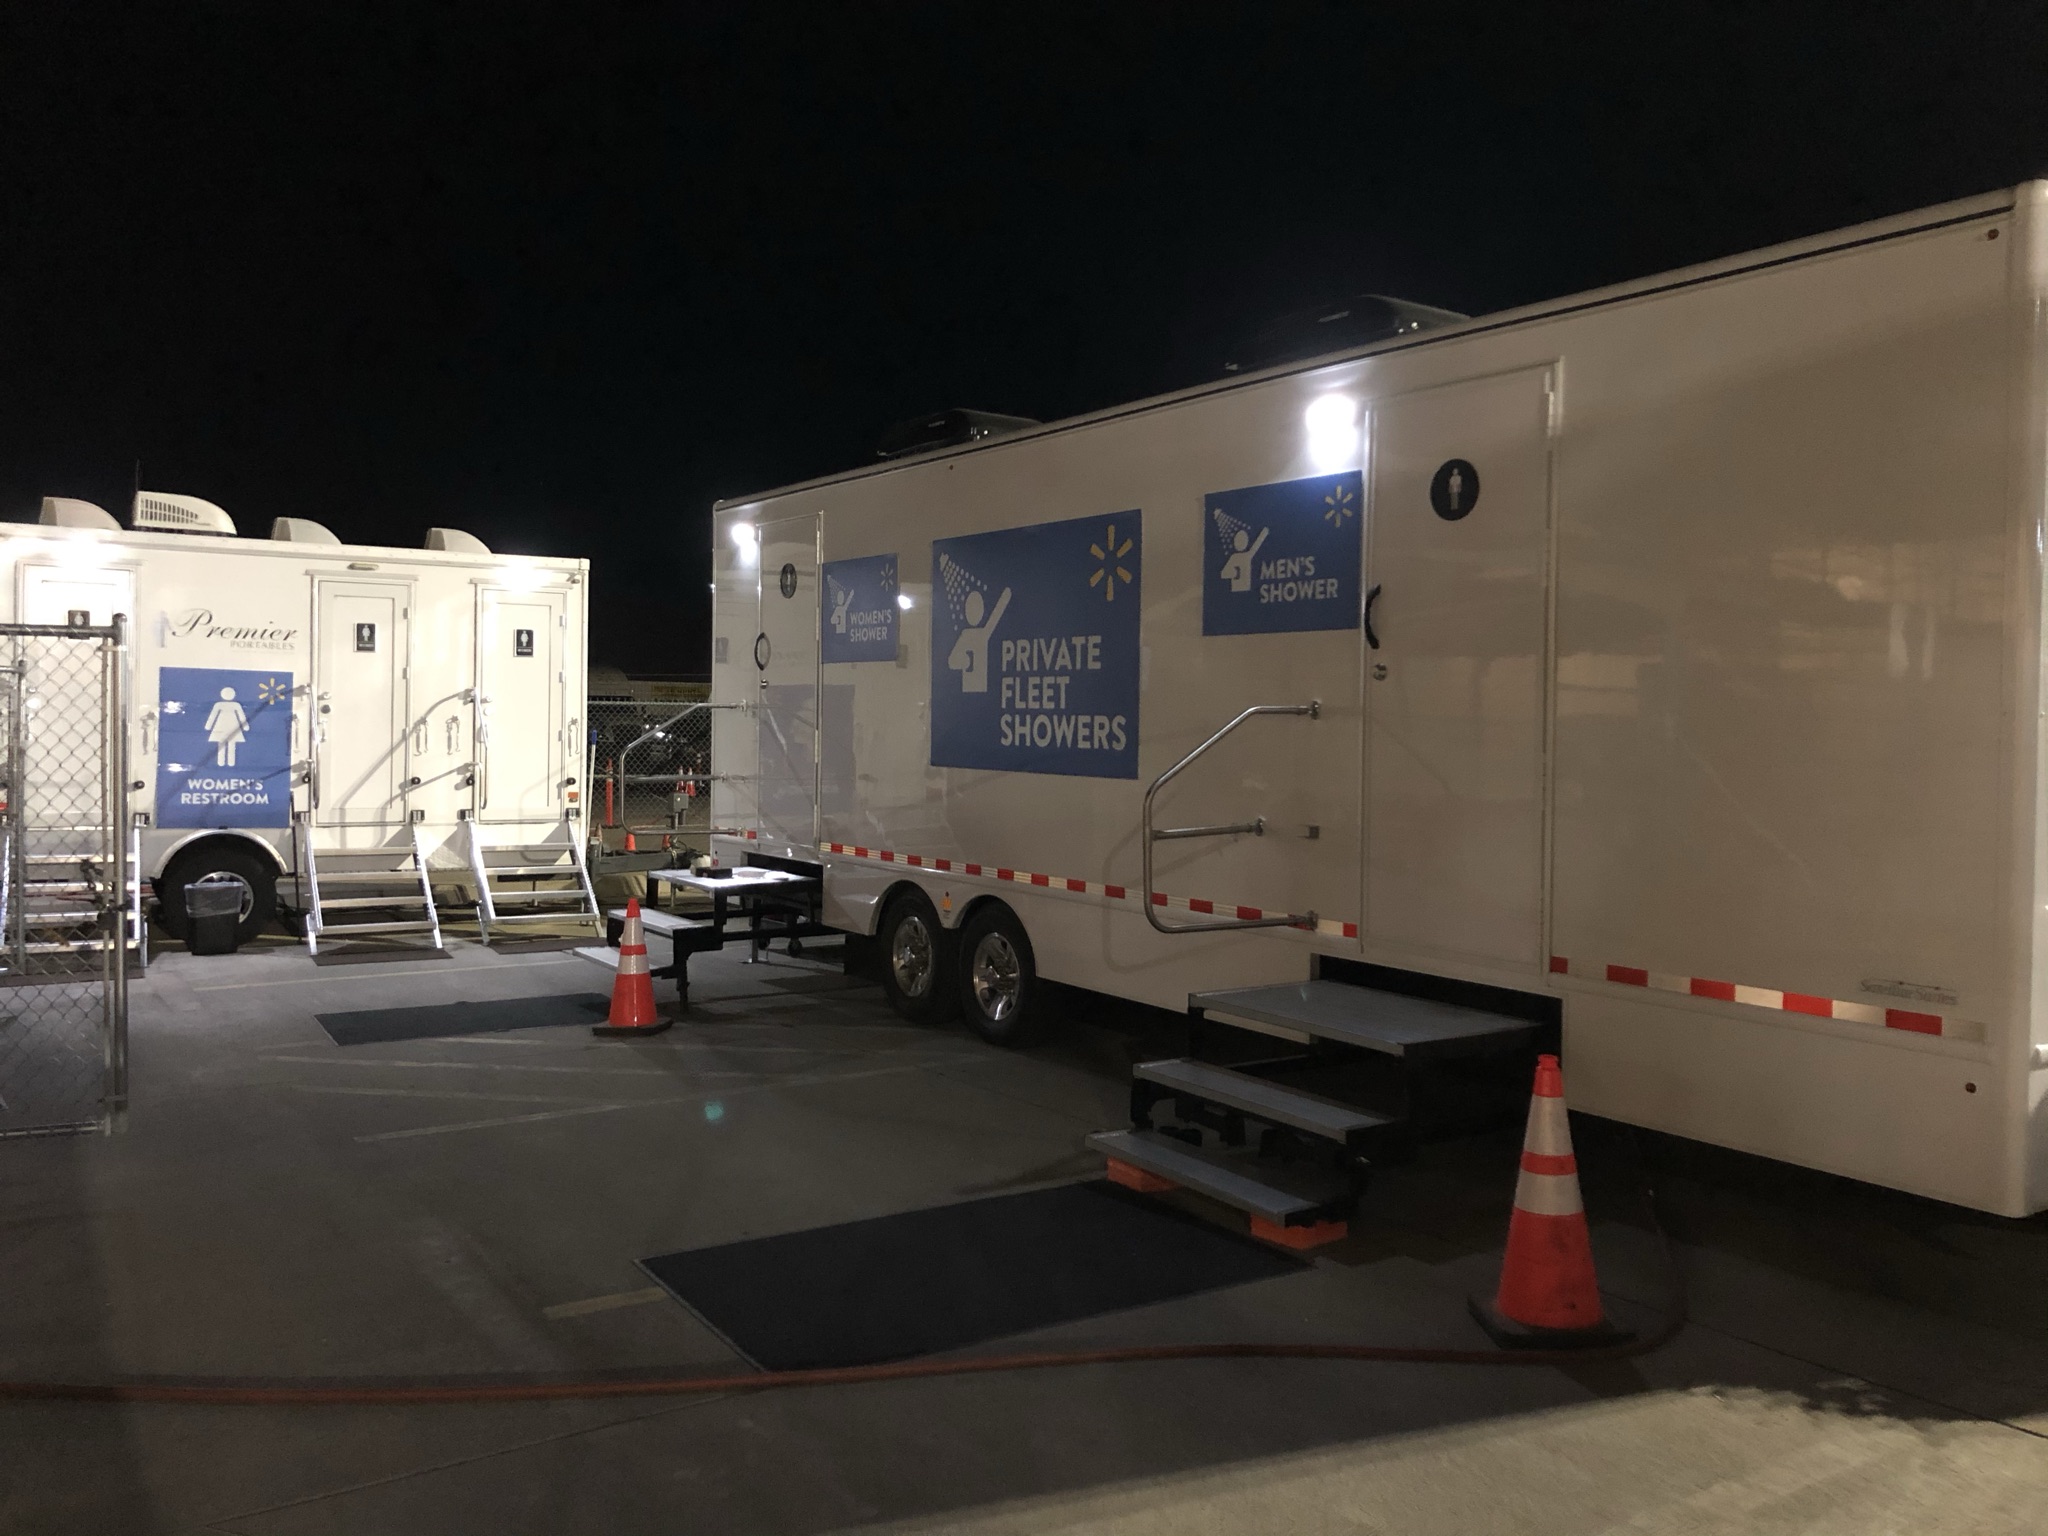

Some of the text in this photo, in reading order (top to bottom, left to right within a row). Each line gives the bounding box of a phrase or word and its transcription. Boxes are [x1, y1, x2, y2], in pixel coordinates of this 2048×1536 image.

[1260, 556, 1316, 579] MEN'S
[1260, 578, 1338, 604] SHOWER
[172, 608, 298, 641] Premier
[849, 609, 892, 625] WOMEN'S
[230, 640, 296, 651] PORTABLES
[850, 627, 888, 642] SHOWER
[1001, 635, 1102, 672] PRIVATE
[1001, 676, 1070, 709] FLEET
[1000, 713, 1127, 751] SHOWERS
[188, 779, 263, 790] WOMEN'S
[181, 793, 269, 805] RESTROOM
